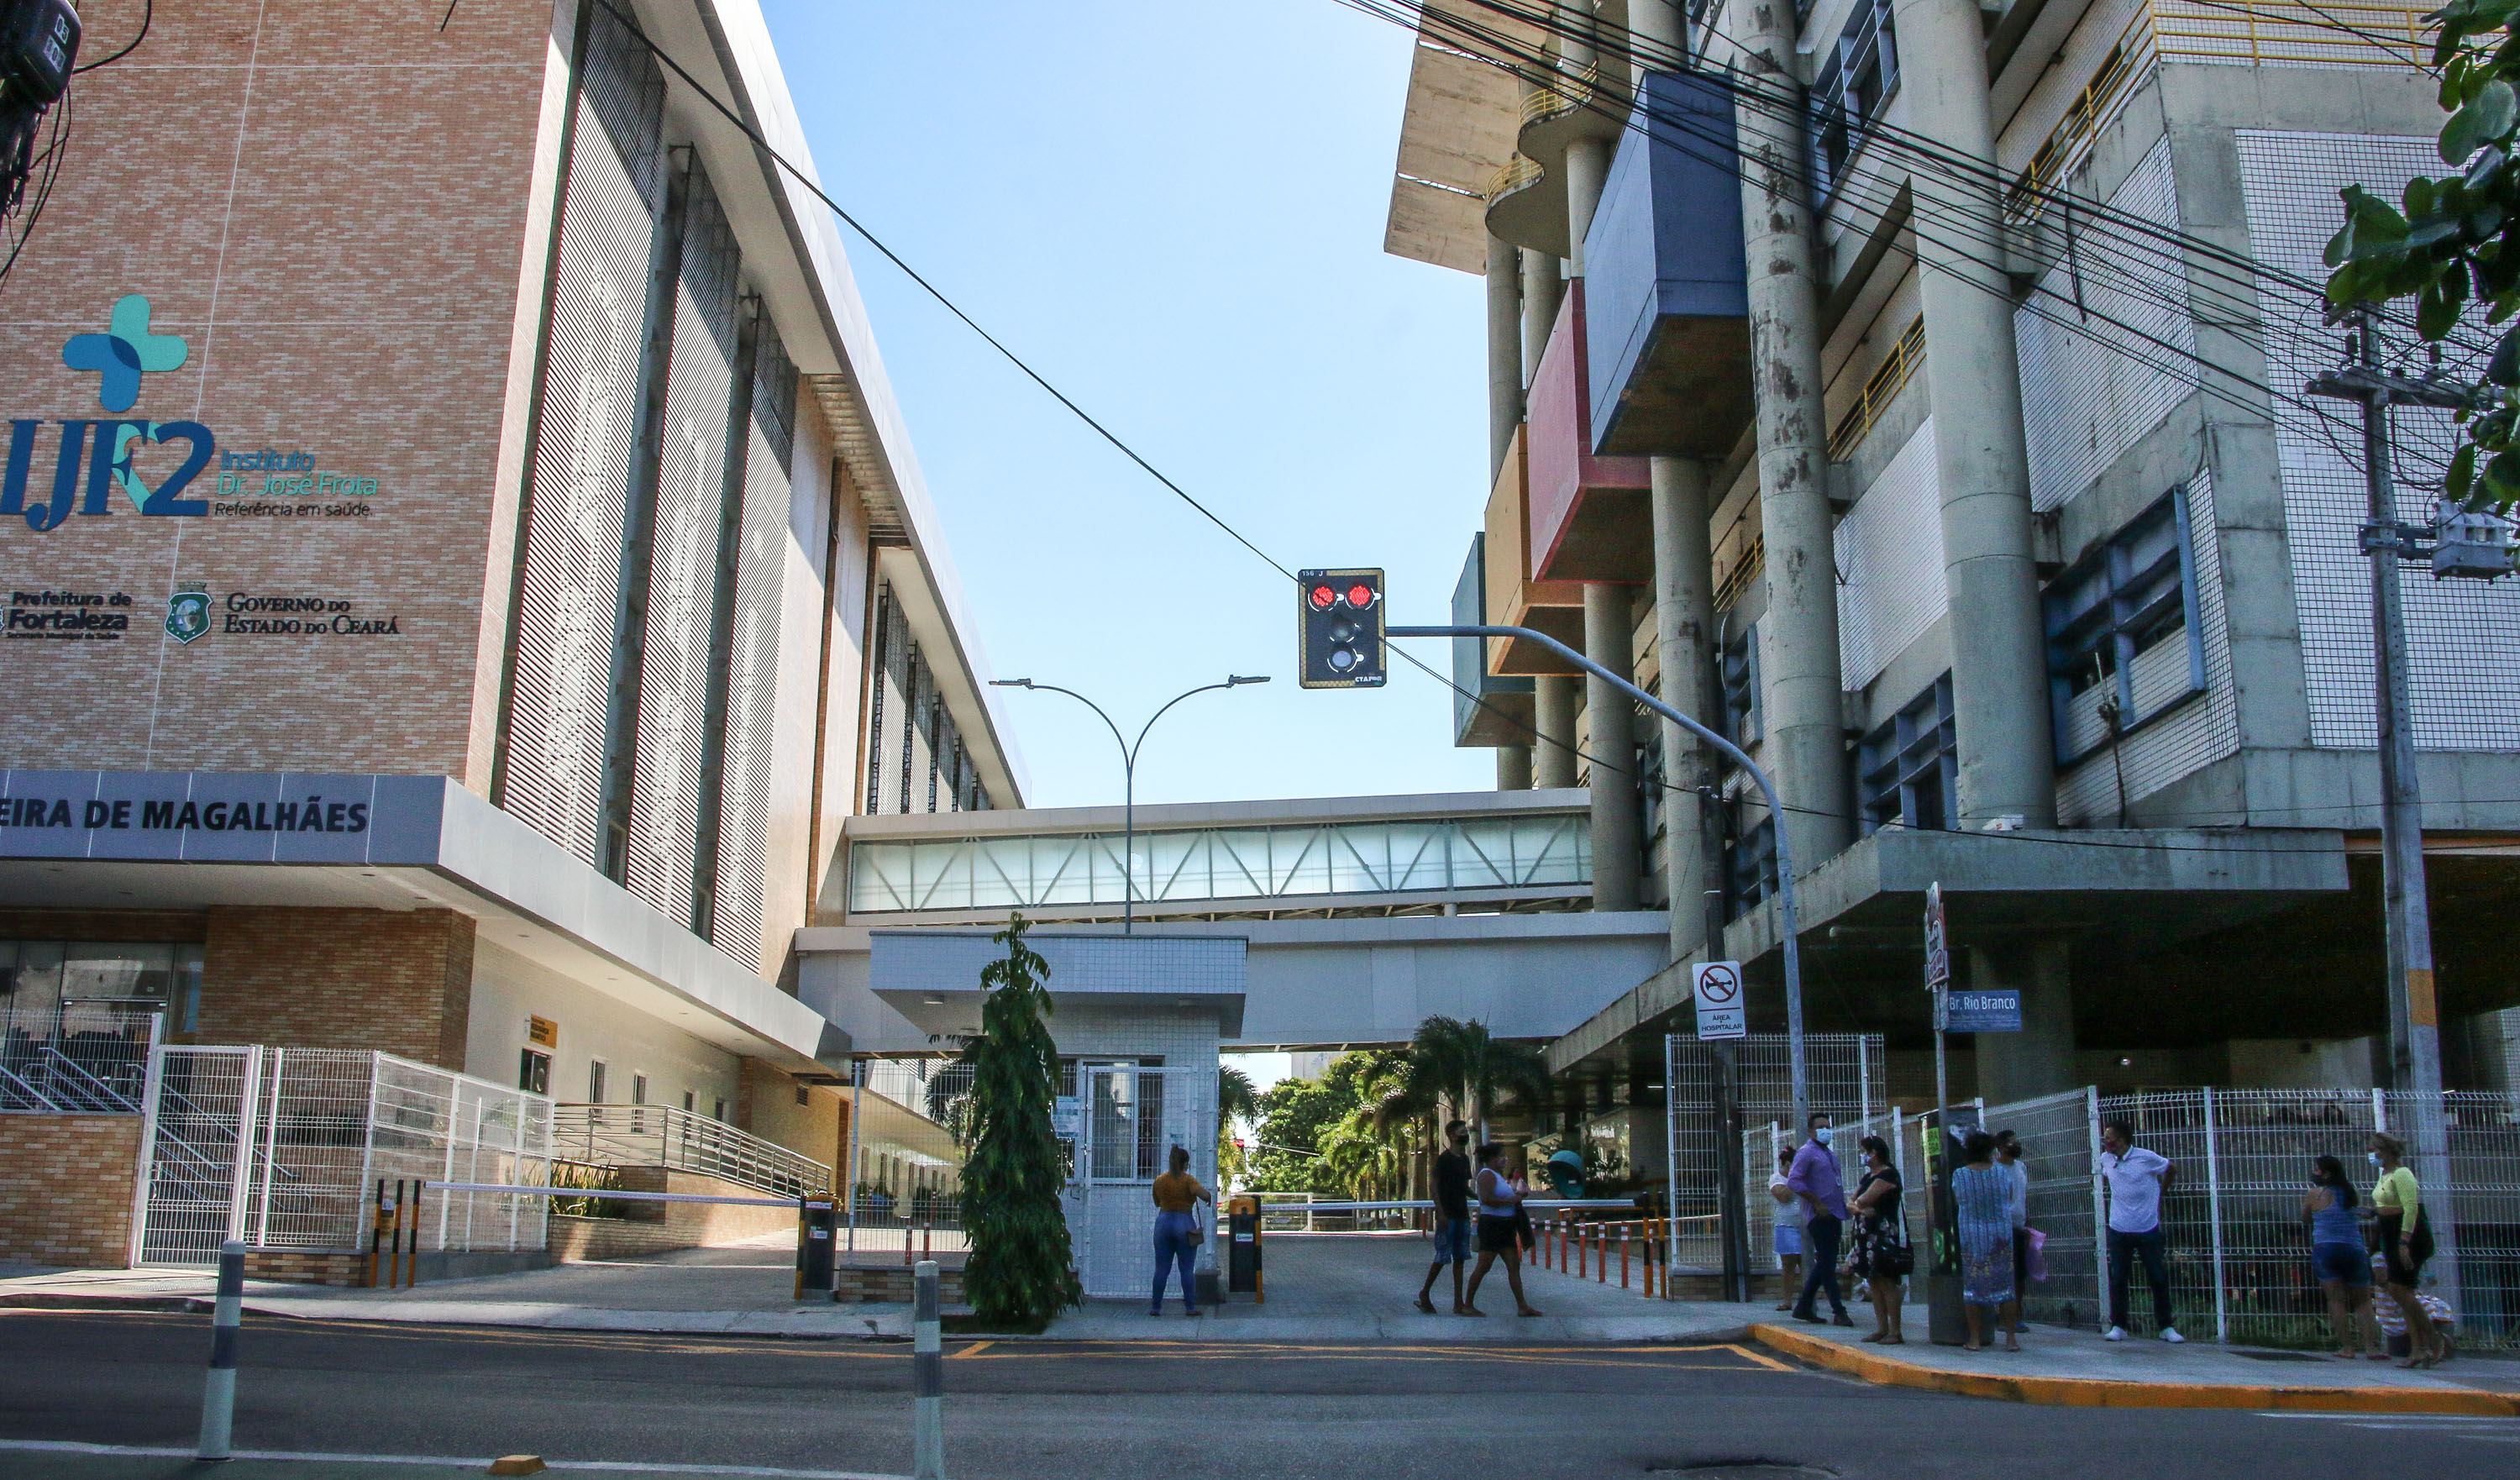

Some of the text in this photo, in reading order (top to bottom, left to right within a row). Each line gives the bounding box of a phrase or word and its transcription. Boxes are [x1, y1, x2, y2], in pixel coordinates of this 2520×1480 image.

[221, 447, 315, 470] Instituto
[217, 472, 378, 496] Dr. José Frota
[214, 501, 373, 517] Referência em saúde.
[13, 590, 133, 606] Prefeitura de
[8, 608, 129, 629] Fortaleza
[84, 799, 132, 829] DE
[142, 795, 367, 832] MAGALHÃES
[1949, 995, 2015, 1010] Br. Rio Branco
[1702, 1023, 1742, 1031] HOSPITALAR
